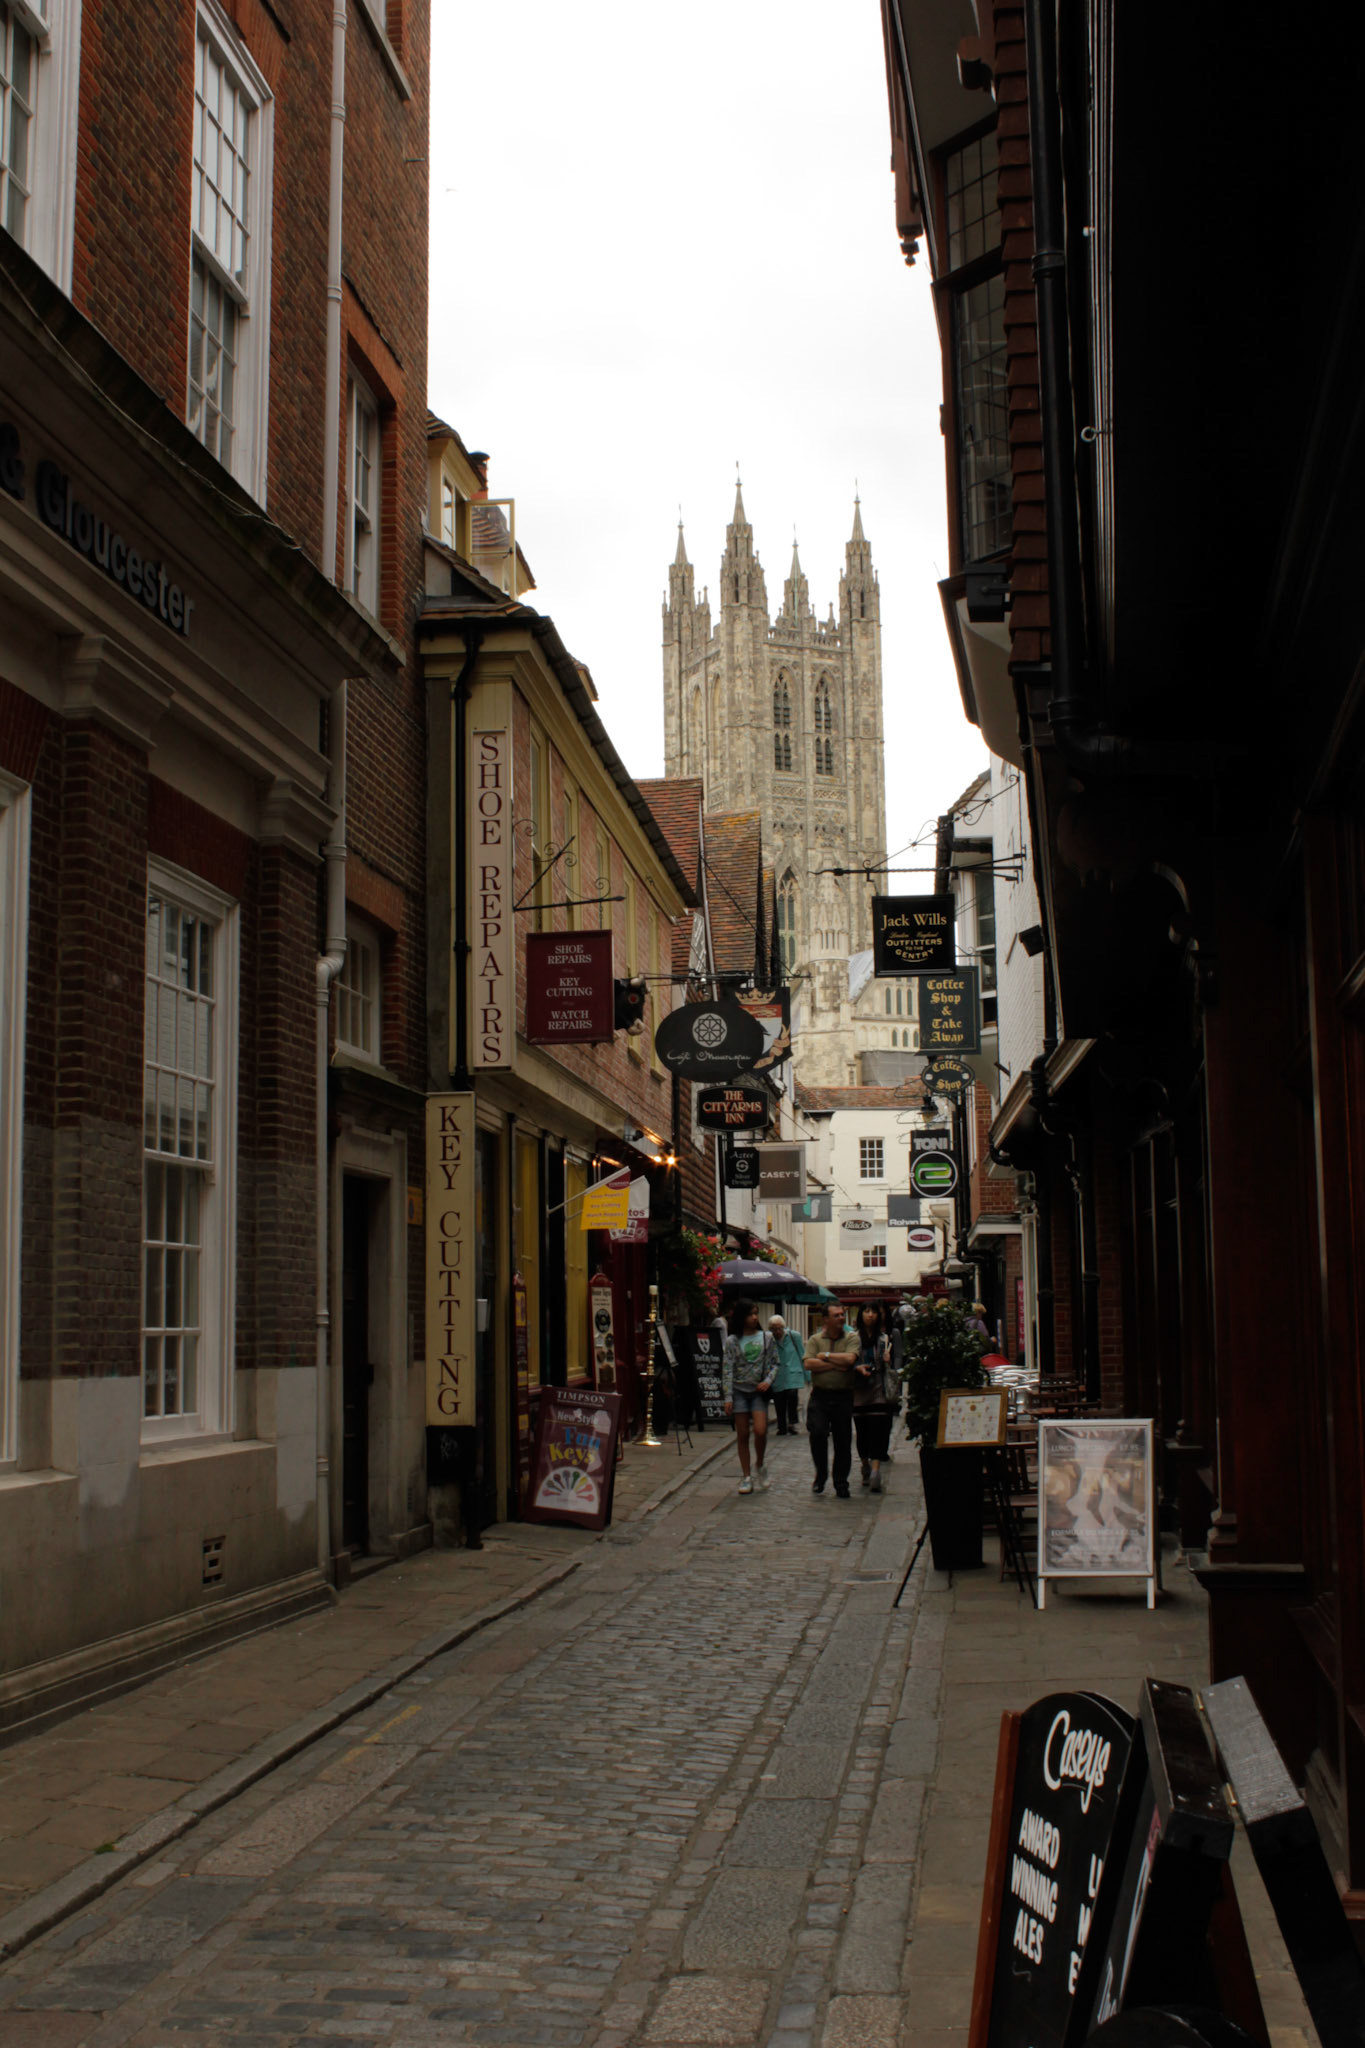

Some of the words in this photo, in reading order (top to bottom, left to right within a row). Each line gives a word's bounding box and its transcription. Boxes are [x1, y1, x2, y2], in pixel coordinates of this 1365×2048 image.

[0, 422, 25, 499] &
[37, 460, 195, 636] Gloucester
[478, 735, 502, 845] SHOE
[880, 913, 910, 931] Jack
[913, 912, 948, 926] Wills
[885, 938, 943, 947] OUTFITTERS
[555, 944, 584, 955] SHOE
[895, 948, 934, 960] GENTRY
[479, 866, 503, 1063] REPAIRS
[547, 954, 593, 965] REPAIRS
[559, 977, 580, 987] KEY
[927, 979, 965, 991] Coffee
[545, 987, 593, 998] CUTTING
[930, 992, 961, 1005] Shop
[551, 1009, 589, 1020] WATCH
[941, 1005, 952, 1016] &
[547, 1019, 593, 1031] REPAIRS
[932, 1018, 962, 1030] Take
[930, 1031, 964, 1043] Away
[932, 1060, 962, 1073] Coffee
[936, 1078, 962, 1092] Shop
[723, 1089, 745, 1101] THE
[702, 1101, 730, 1112] CITY
[730, 1101, 763, 1113] ARMS
[724, 1113, 745, 1124] INN
[438, 1105, 461, 1191] KEY
[913, 1137, 948, 1151] TONI
[628, 1209, 645, 1217] tos
[844, 1220, 870, 1229] Blacks
[437, 1210, 463, 1416] CUTTING
[557, 1391, 606, 1403] TIMPSON
[563, 1426, 600, 1448] Fun
[549, 1442, 595, 1465] Keys
[1044, 1709, 1111, 1814] Caseys
[1018, 1808, 1060, 1870] AWARD
[1011, 1853, 1058, 1924] WINNING
[1013, 1908, 1044, 1965] ALES
